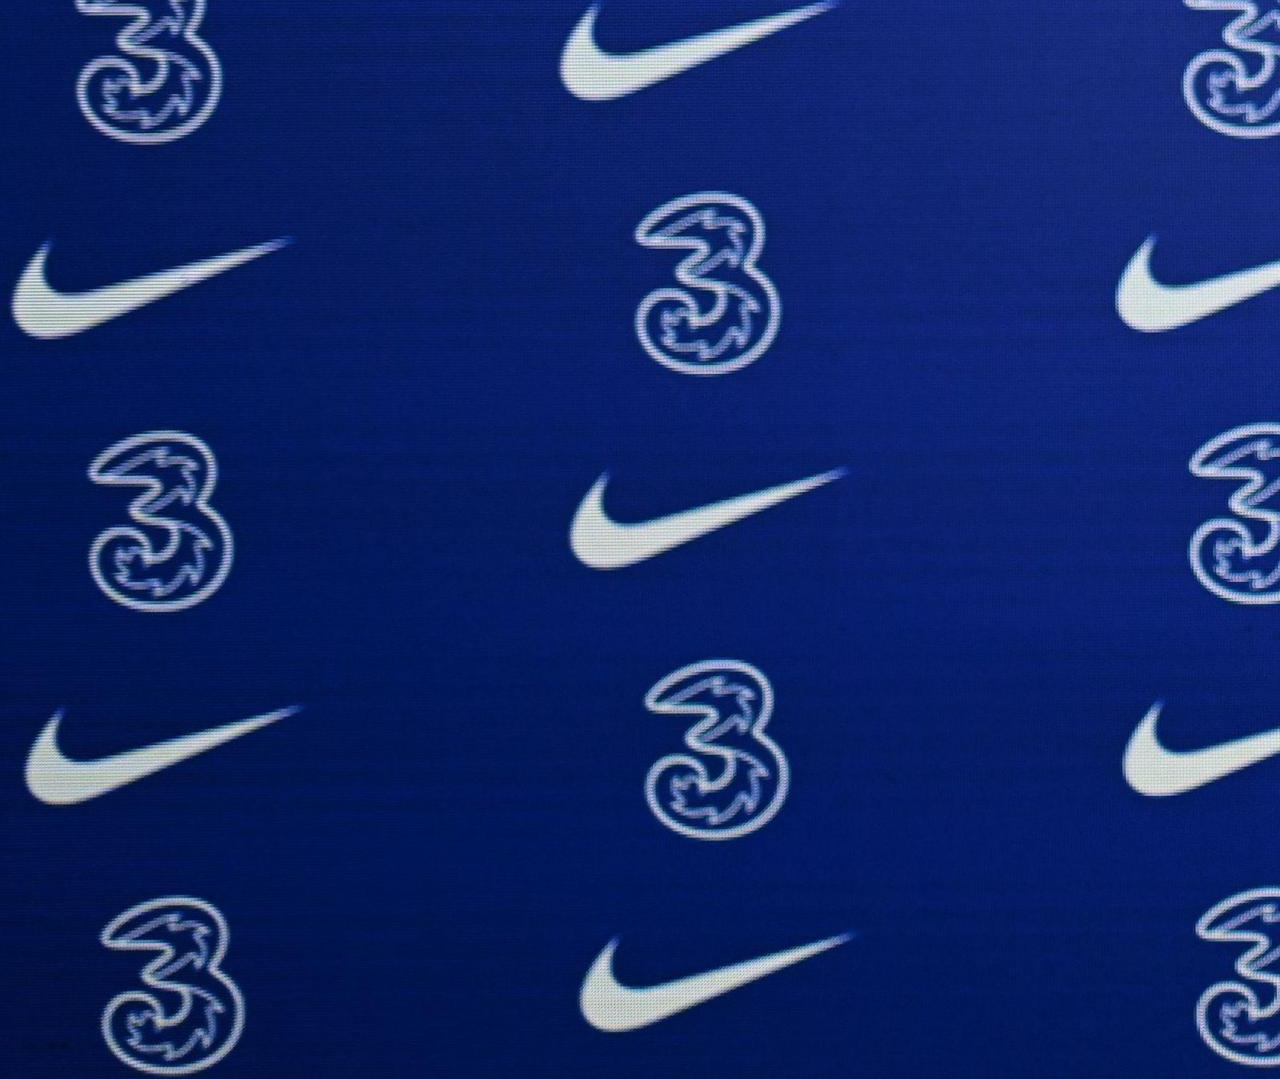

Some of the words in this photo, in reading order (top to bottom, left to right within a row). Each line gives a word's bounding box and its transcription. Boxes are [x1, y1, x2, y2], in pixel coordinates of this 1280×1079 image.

[635, 191, 780, 375] 3
[87, 431, 233, 613] 3
[645, 660, 789, 840] 3
[100, 897, 245, 1075] 3
